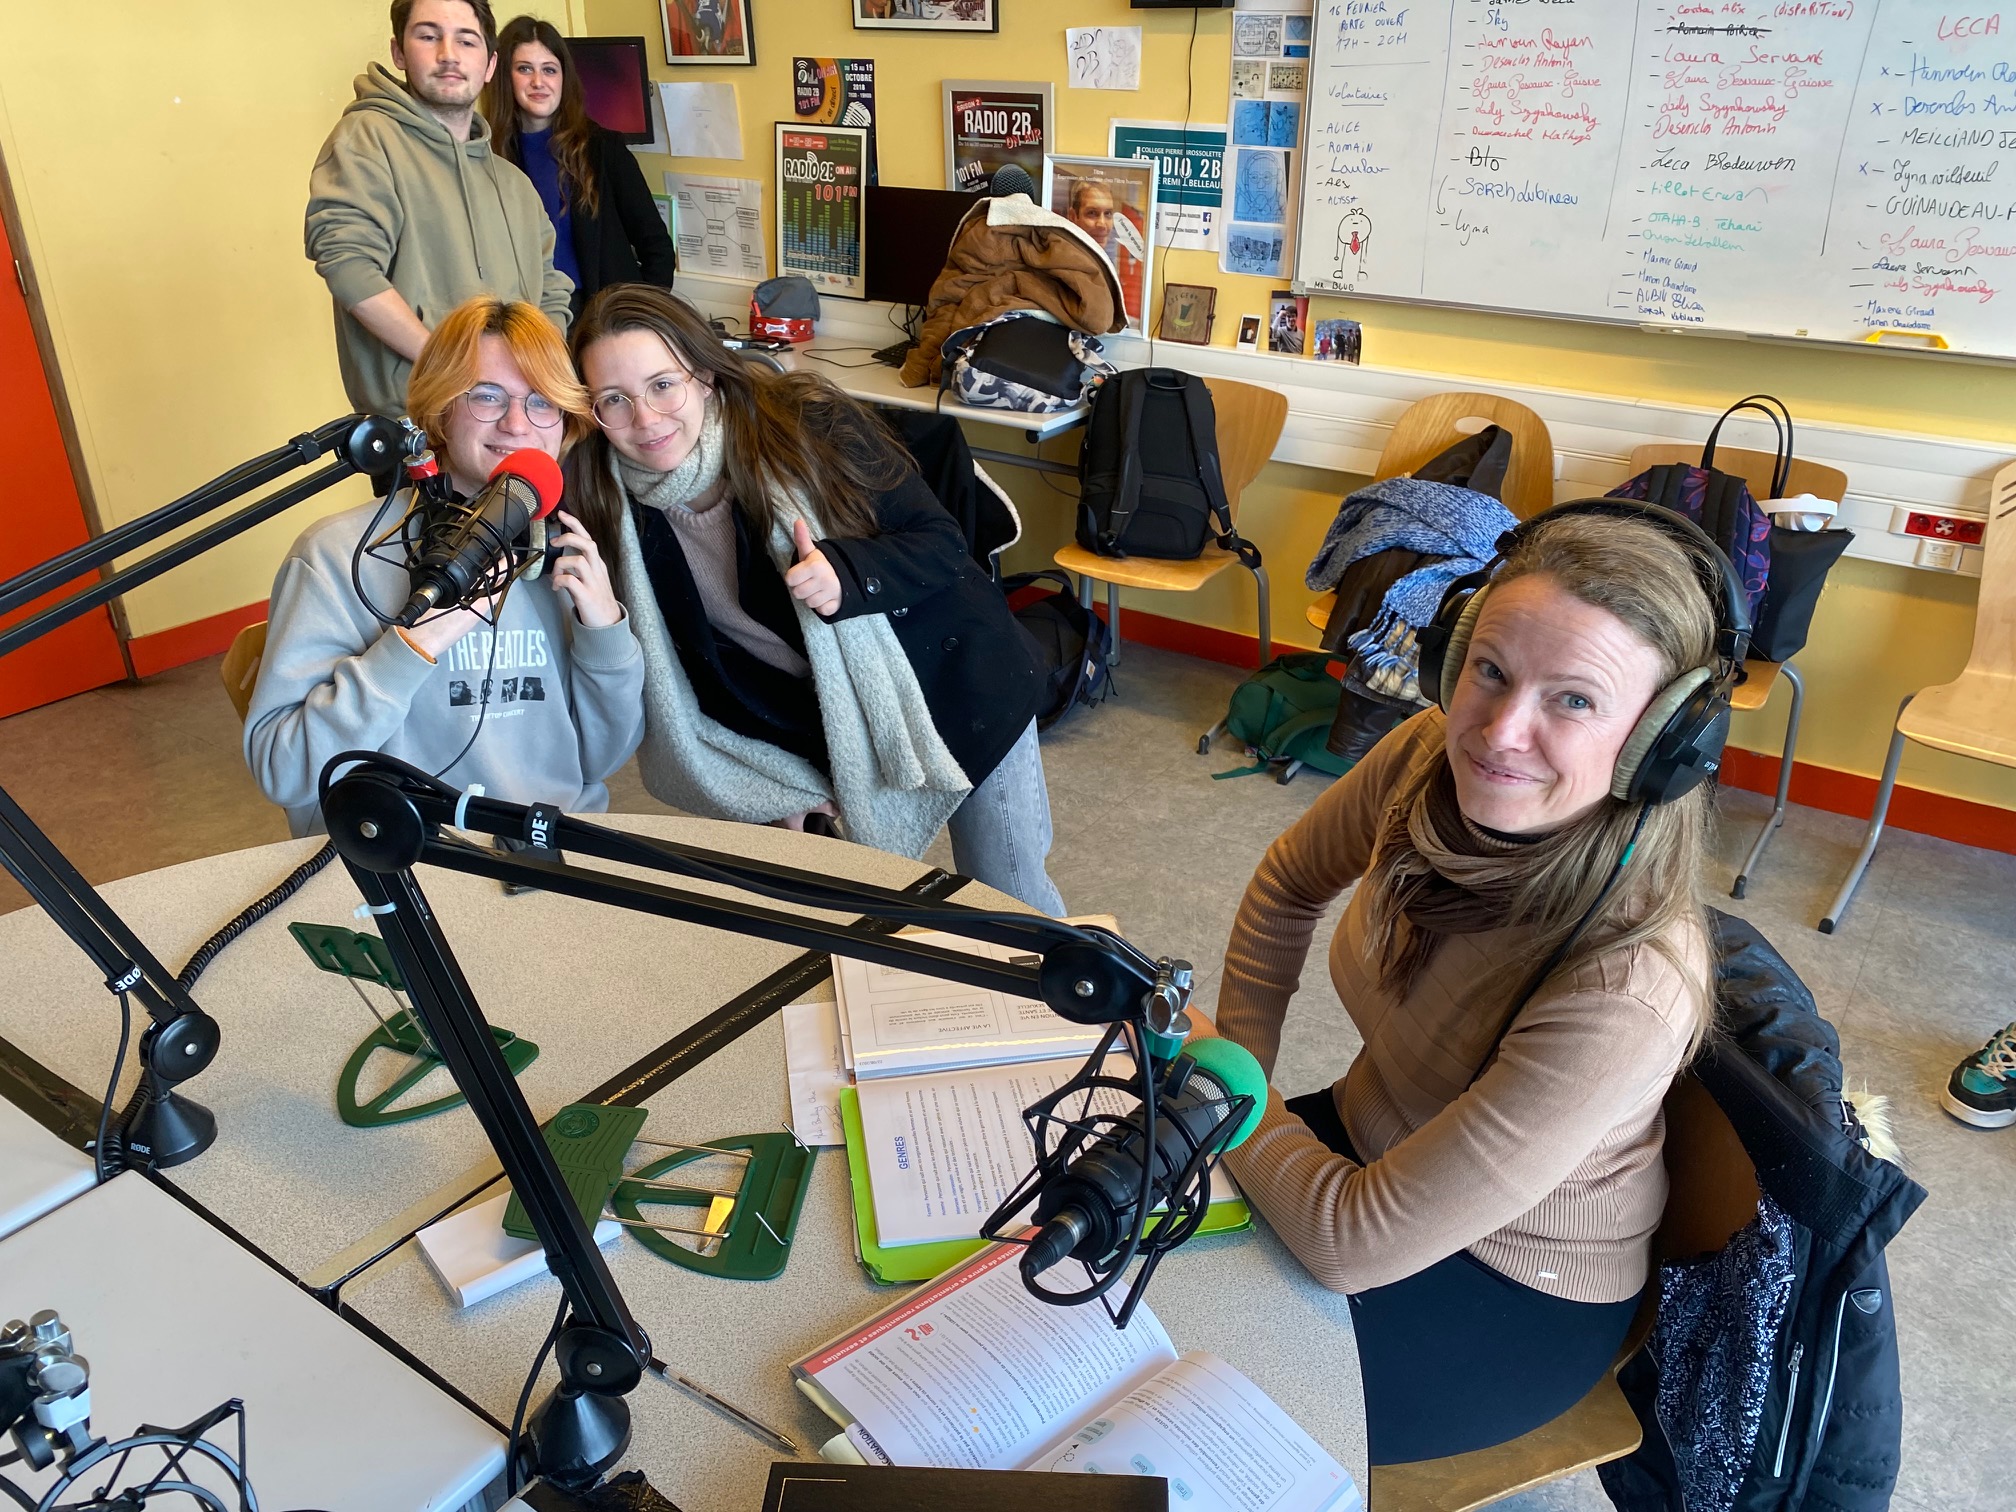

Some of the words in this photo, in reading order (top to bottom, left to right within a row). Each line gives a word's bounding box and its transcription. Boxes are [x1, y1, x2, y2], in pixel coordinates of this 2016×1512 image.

[1329, 6, 1340, 15] 16
[1665, 44, 1724, 64] Laura
[851, 63, 858, 71] 15
[845, 74, 872, 82] OCTOBRE
[797, 87, 811, 96] RADIO
[798, 99, 810, 110] 101
[964, 110, 1007, 134] RADIO
[784, 158, 819, 180] RADIO
[956, 166, 969, 183] 101
[969, 160, 984, 178] FM
[1200, 158, 1221, 178] 2B
[815, 184, 842, 202] 101
[1189, 178, 1220, 189] BELLEAU
[895, 1136, 909, 1170] GENRES
[965, 1262, 988, 1280] genre
[913, 1280, 959, 1311] orientations
[866, 1306, 916, 1339] romantiques
[821, 1340, 859, 1366] sexuelles
